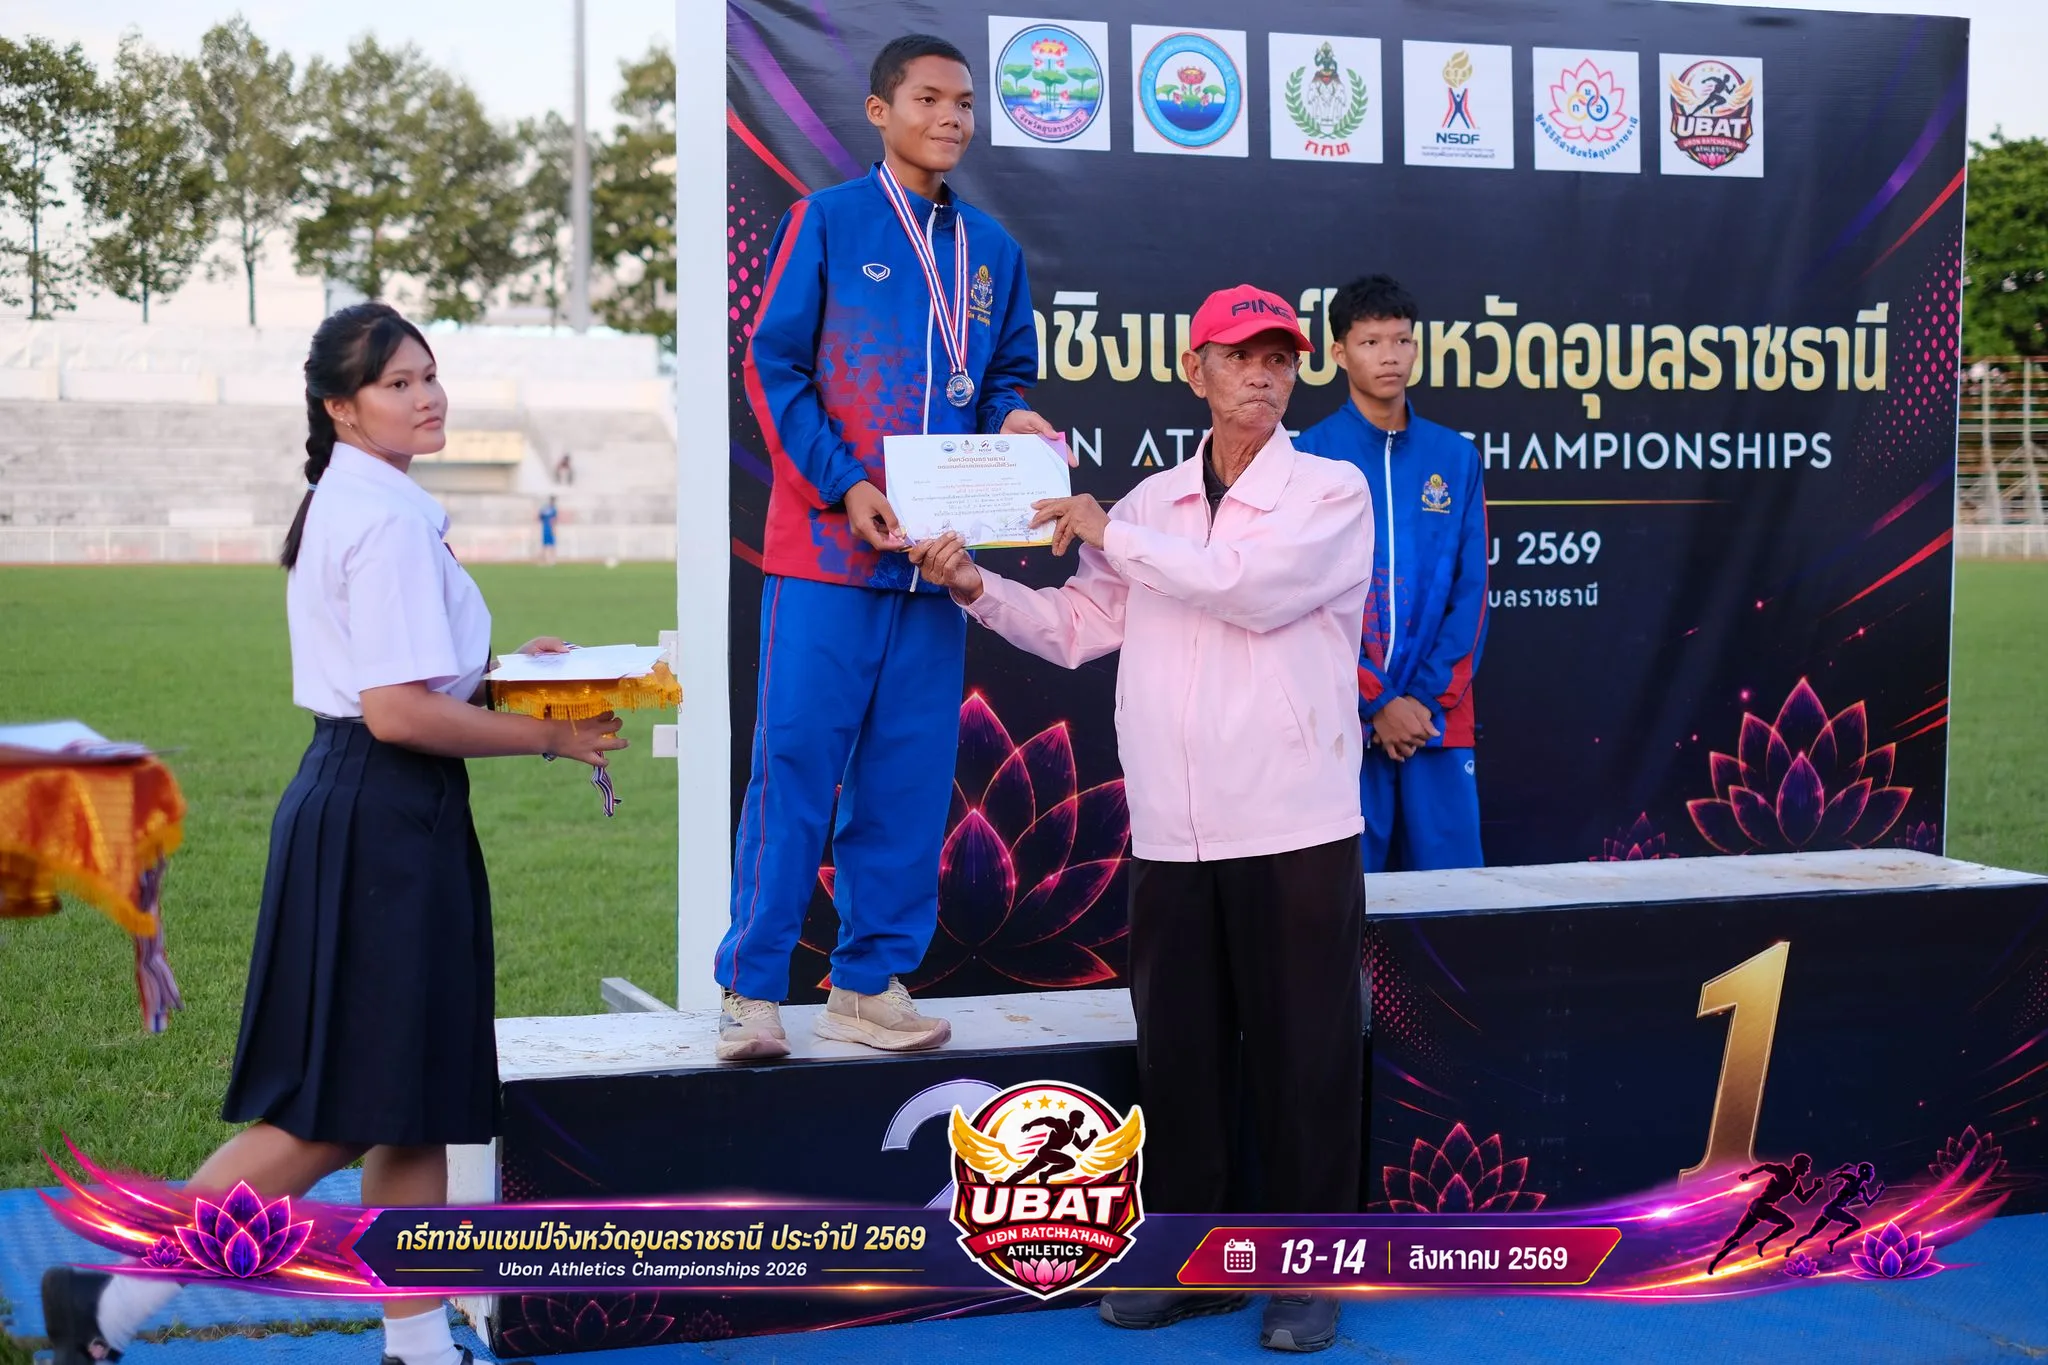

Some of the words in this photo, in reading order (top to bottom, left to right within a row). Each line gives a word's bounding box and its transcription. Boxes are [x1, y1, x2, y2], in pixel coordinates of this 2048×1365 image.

[1436, 132, 1480, 145] NSDF
[1676, 115, 1748, 139] UBAT
[1231, 298, 1293, 322] PING
[1459, 431, 1833, 471] HAMPIONSHIPS
[1516, 531, 1601, 565] 2569
[1677, 941, 1790, 1187] 1
